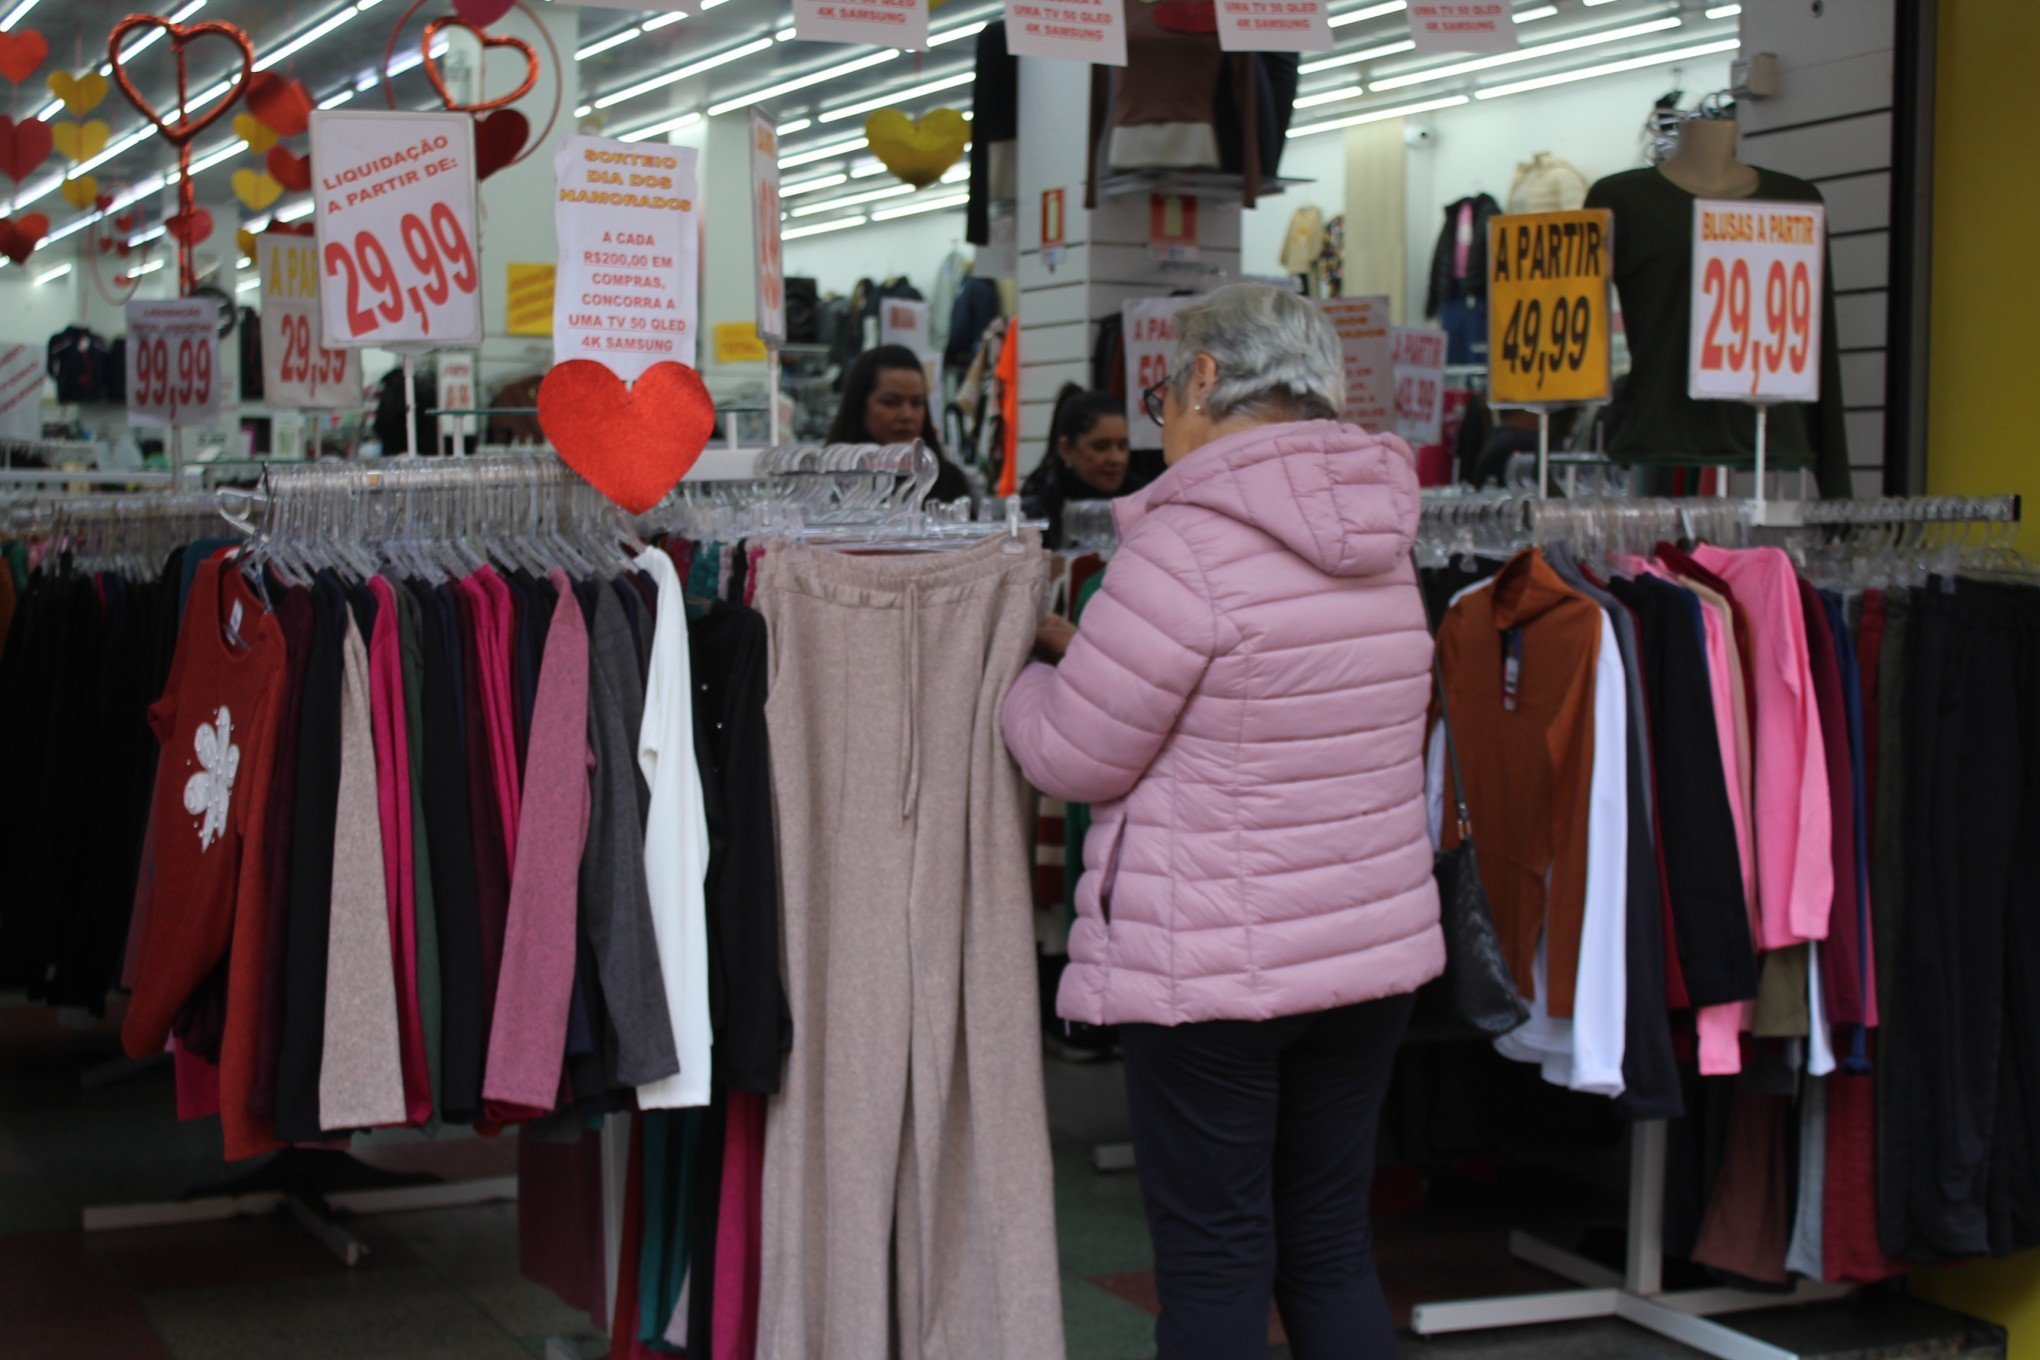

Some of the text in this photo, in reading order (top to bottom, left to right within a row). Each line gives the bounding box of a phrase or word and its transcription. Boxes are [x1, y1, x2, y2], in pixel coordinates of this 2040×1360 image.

[840, 8, 907, 23] SAMSUNG
[1045, 24, 1104, 40] SAMSUNG
[322, 135, 449, 191] LIQUIDAÇÃO
[584, 149, 678, 170] SORTEIO
[326, 157, 459, 216] A PARTIR DE:
[585, 169, 673, 190] DIA DOS
[559, 188, 692, 213] NAMORADOS
[602, 231, 655, 247] A CADA
[1702, 211, 1815, 246] BLUSAS A PARTIR
[652, 255, 673, 268] EM
[1494, 220, 1602, 283] A PARTIR
[323, 201, 478, 338] 29,99
[591, 272, 666, 290] COMPRAS,
[581, 292, 676, 311] CONCORRA A
[568, 314, 603, 327] UMA
[606, 316, 627, 328] TV
[630, 317, 647, 330] 50
[650, 318, 687, 332] QLED
[1701, 257, 1811, 396] 29,99
[581, 336, 673, 353] 4K SAMSUNG
[1501, 295, 1592, 391] 49,99
[135, 337, 213, 421] 99,99
